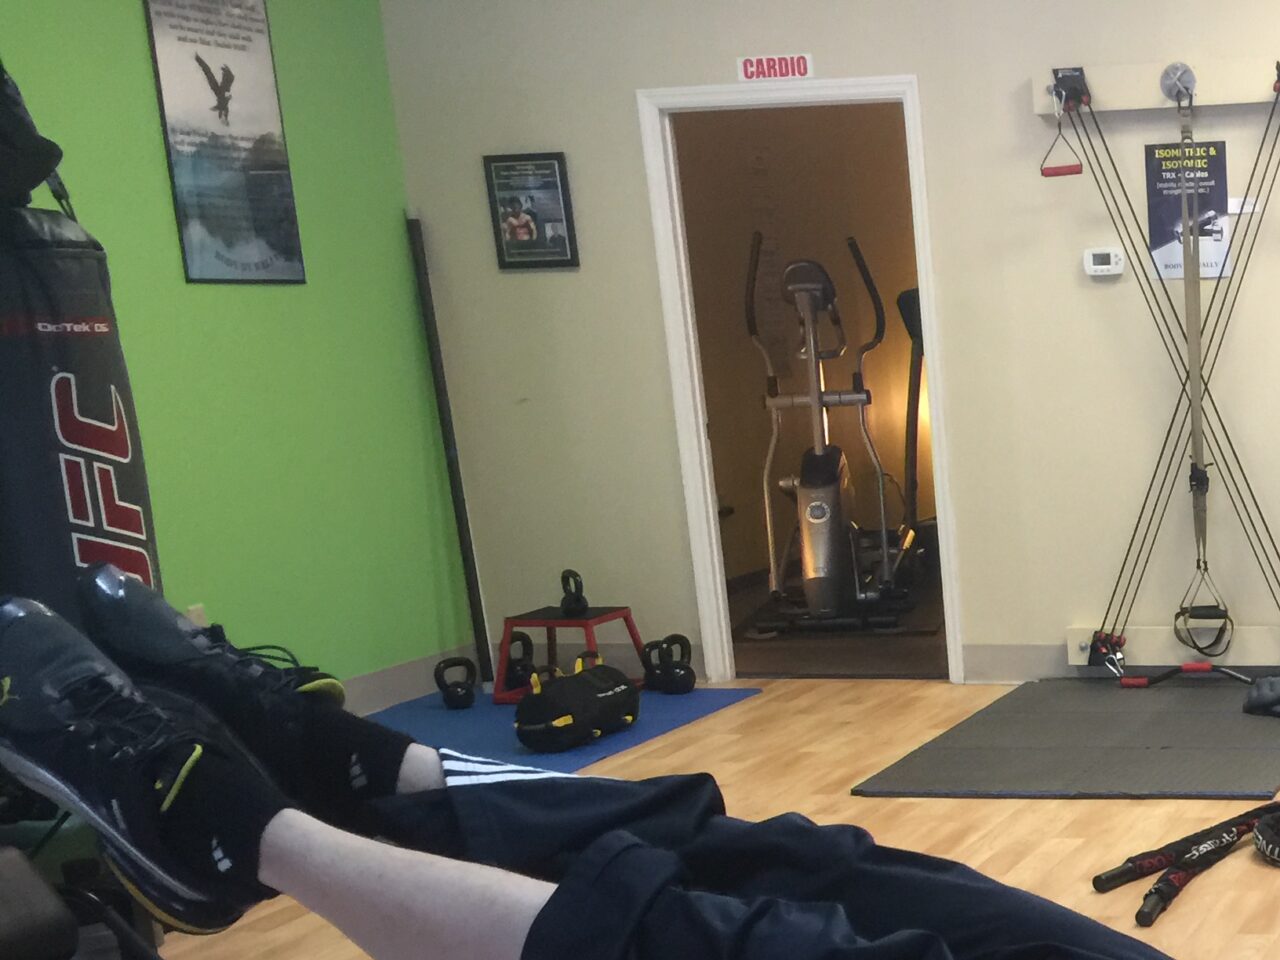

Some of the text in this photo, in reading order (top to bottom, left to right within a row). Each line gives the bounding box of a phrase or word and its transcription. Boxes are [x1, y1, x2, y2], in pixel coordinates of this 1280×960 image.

[743, 55, 808, 79] CARDIO
[1208, 146, 1216, 156] &
[51, 372, 153, 589] UFC
